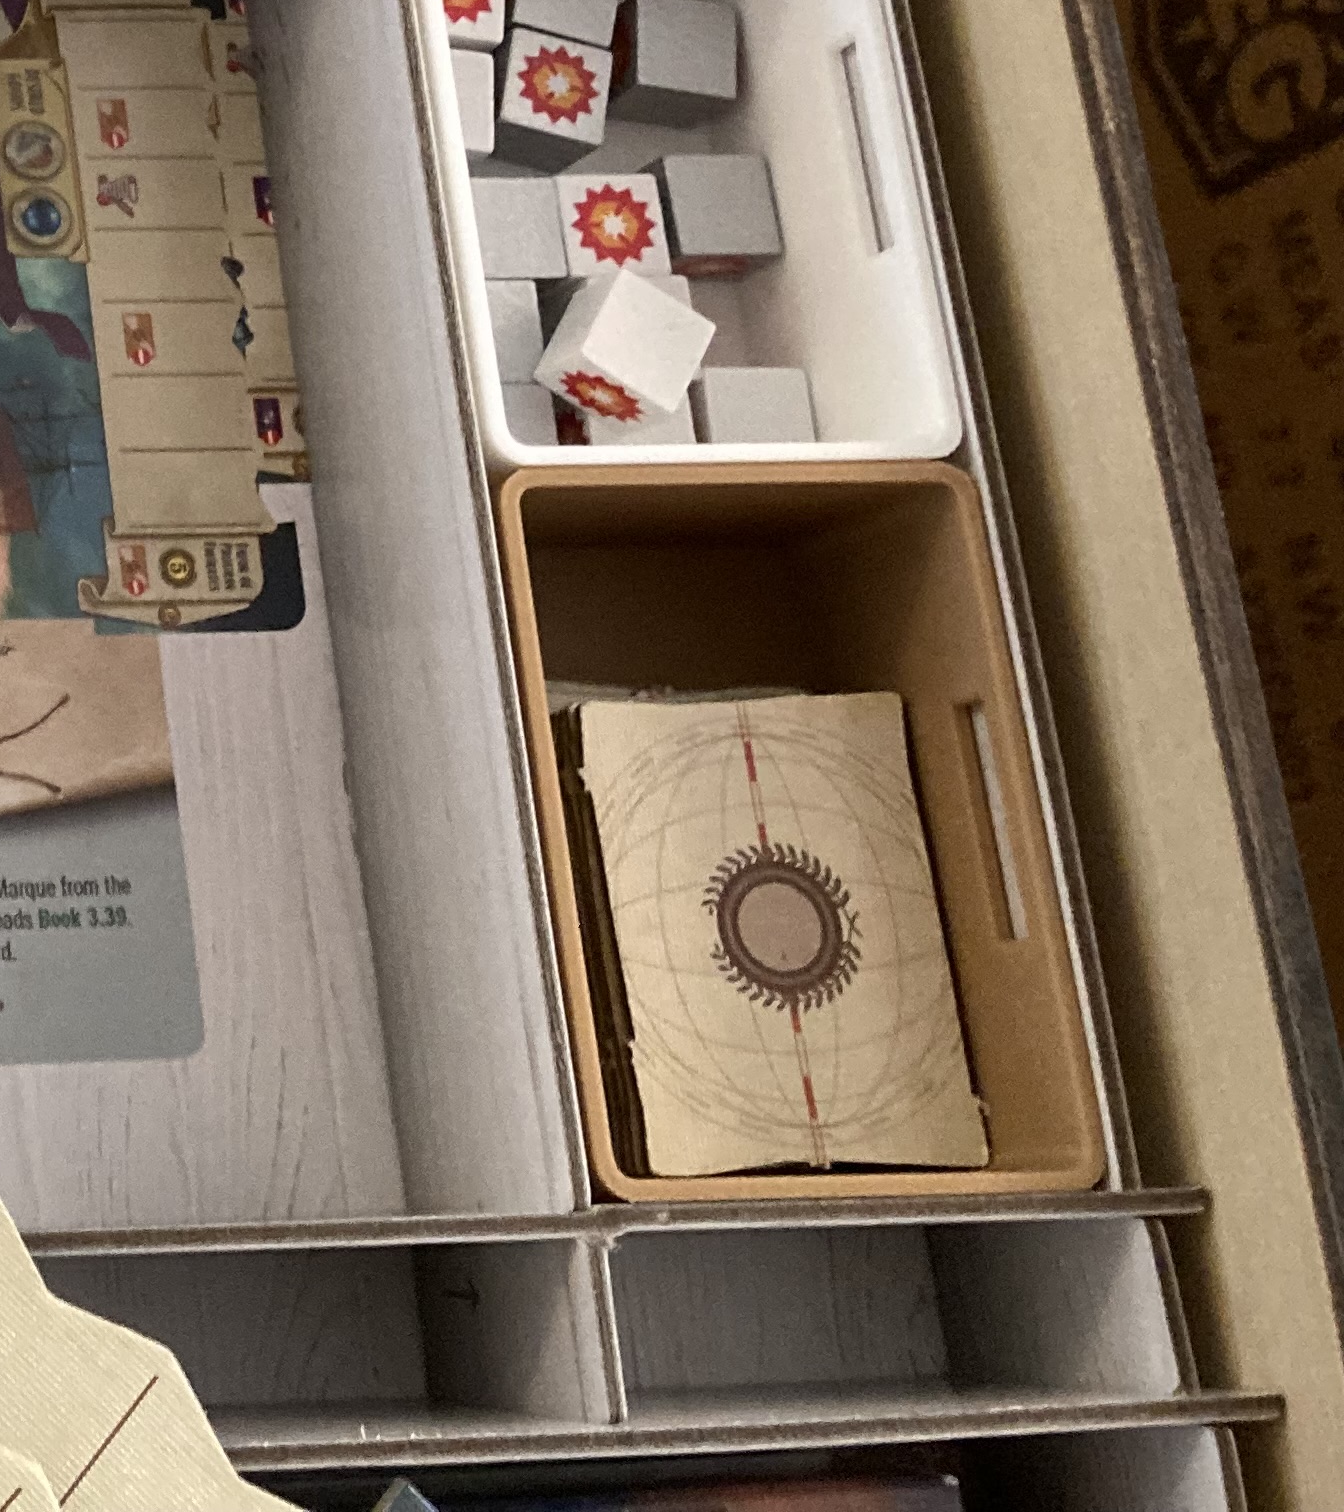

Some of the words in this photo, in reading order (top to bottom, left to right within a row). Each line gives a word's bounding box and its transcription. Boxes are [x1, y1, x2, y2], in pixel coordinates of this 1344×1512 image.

[60, 875, 100, 897] from
[104, 875, 132, 896] the
[38, 906, 81, 930] Book
